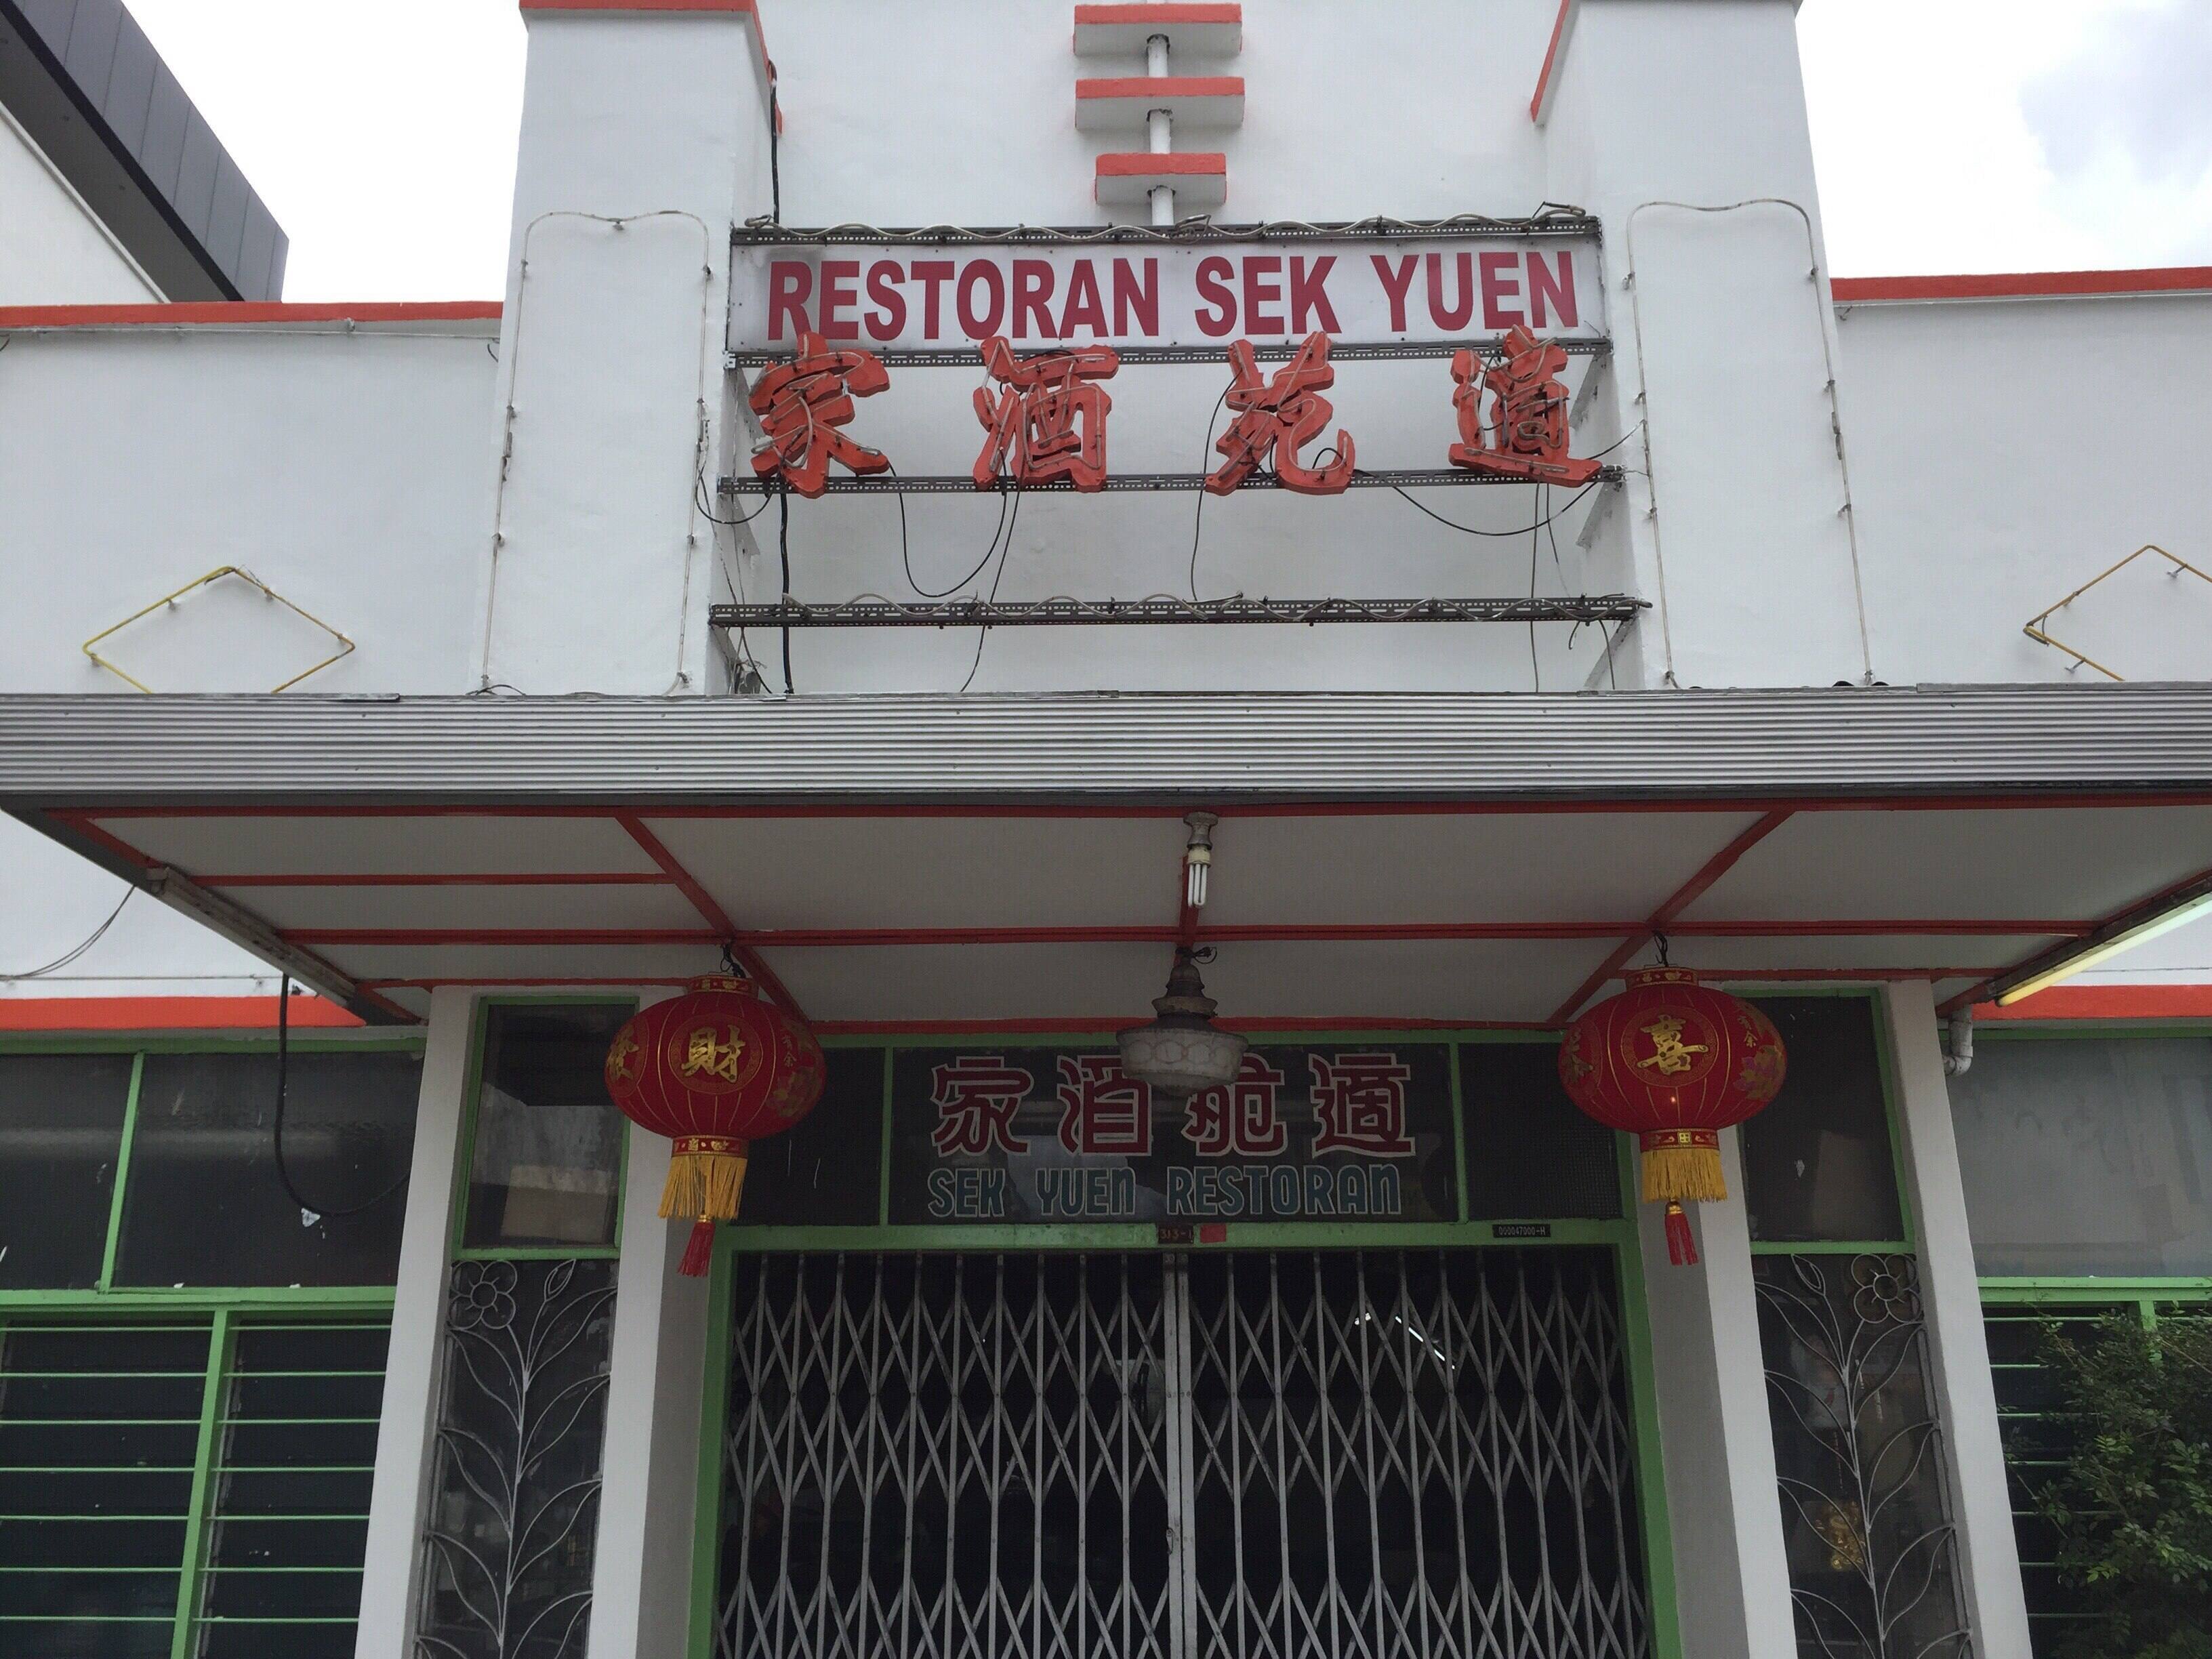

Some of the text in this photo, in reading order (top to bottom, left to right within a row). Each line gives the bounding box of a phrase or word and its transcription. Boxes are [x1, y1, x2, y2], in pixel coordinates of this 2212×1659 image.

[768, 250, 1578, 342] RESTORAN SEK YUEN
[680, 1024, 746, 1084] 財
[927, 1162, 1401, 1218] SEK YUEN RESTORAN
